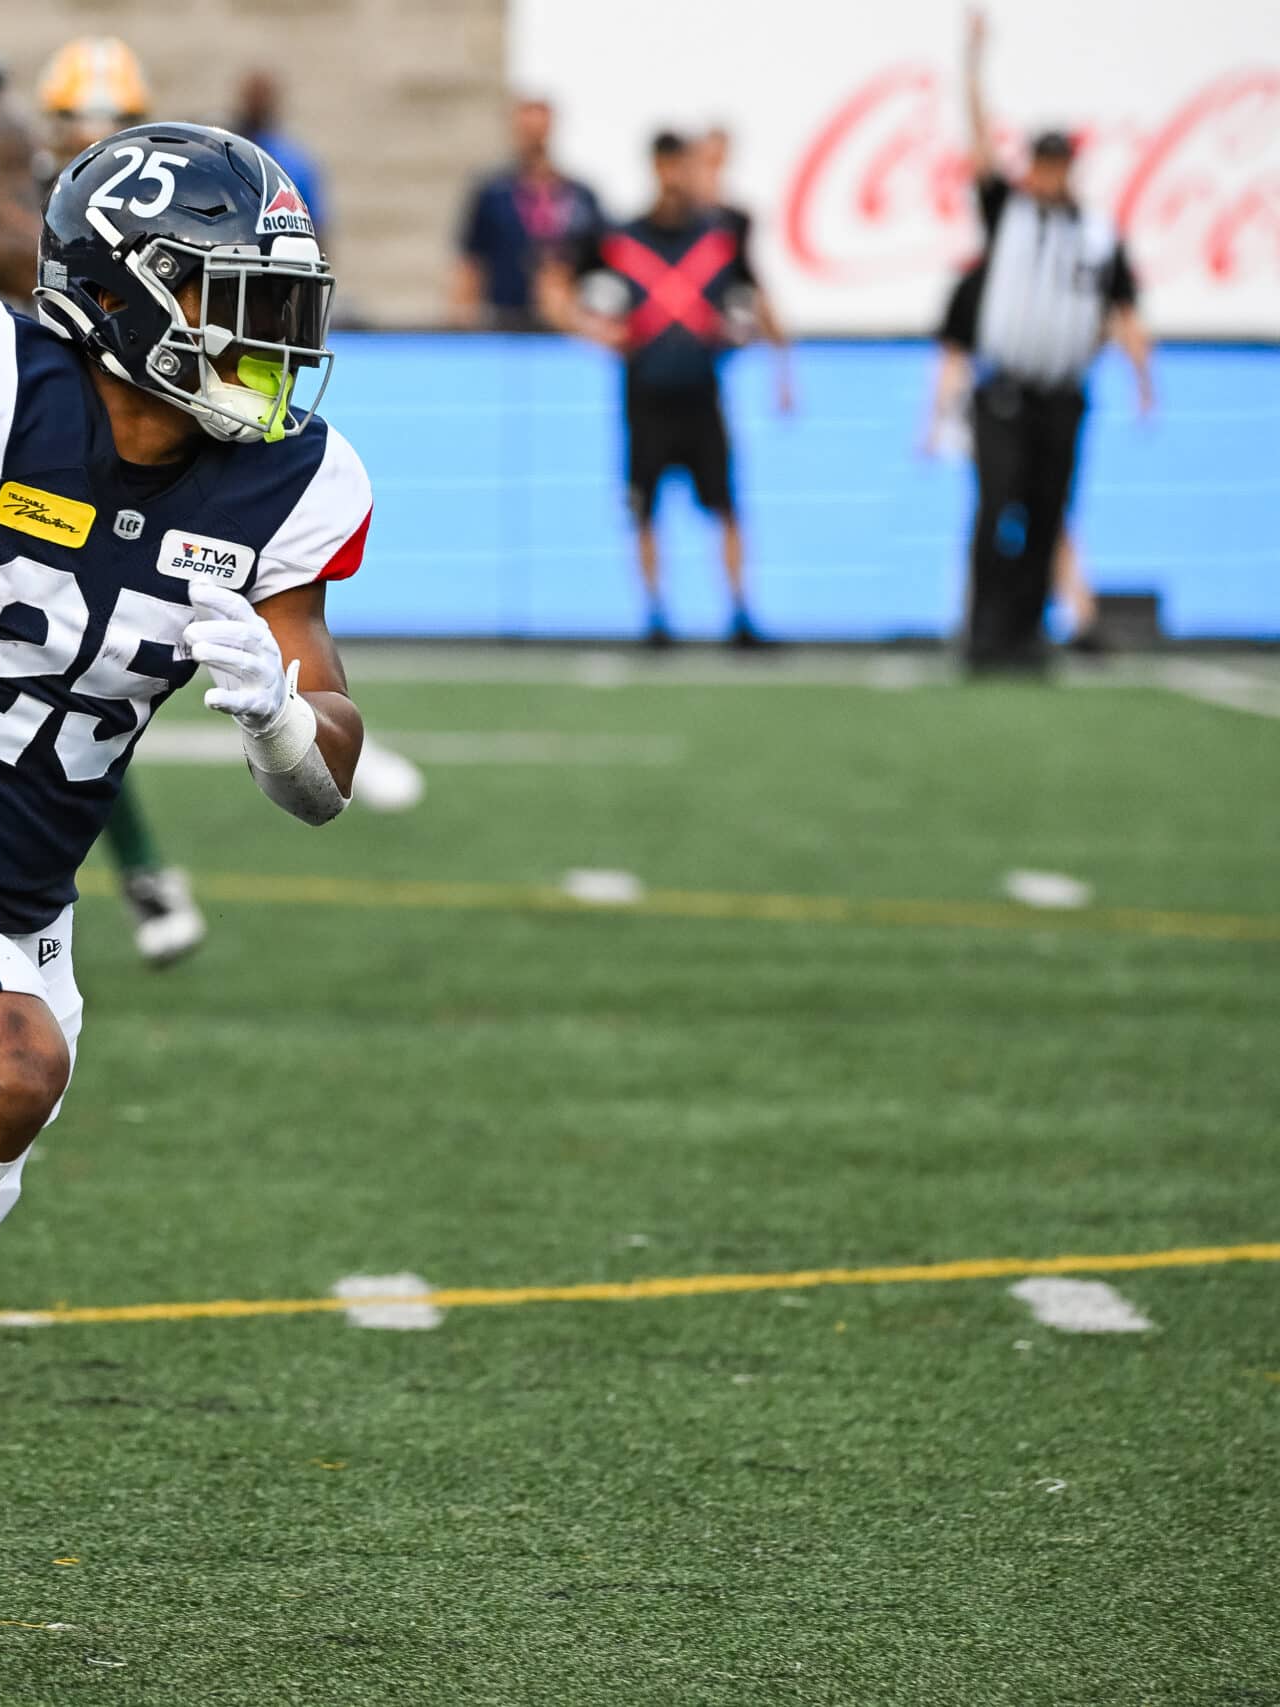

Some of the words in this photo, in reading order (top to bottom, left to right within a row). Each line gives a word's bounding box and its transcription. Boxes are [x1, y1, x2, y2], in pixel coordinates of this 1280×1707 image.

[87, 146, 190, 218] 25
[120, 517, 141, 534] LCF
[171, 557, 235, 579] SPORTS
[201, 547, 237, 569] TVA
